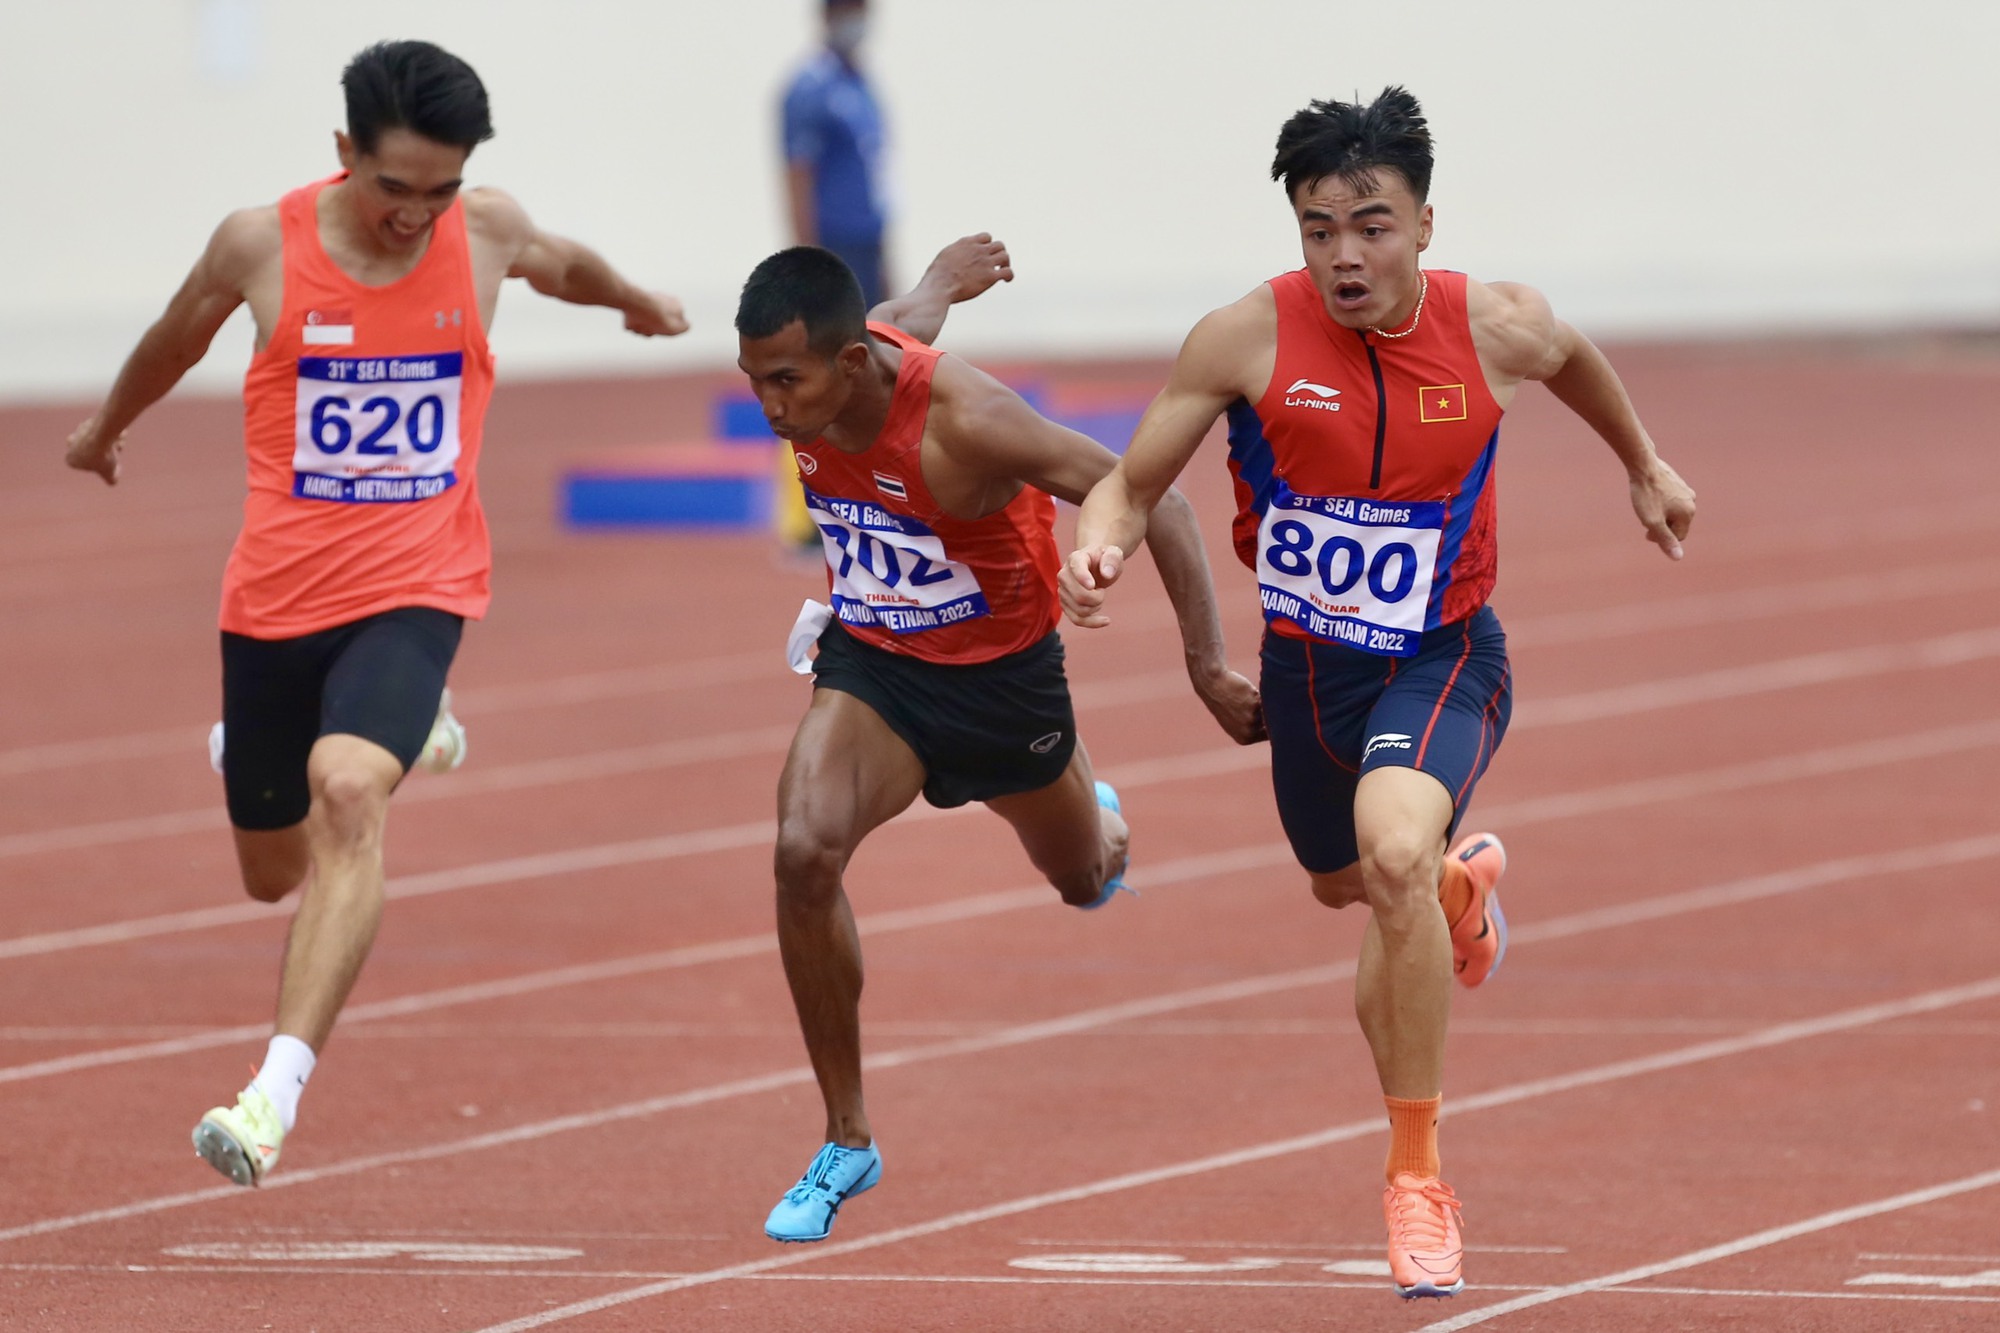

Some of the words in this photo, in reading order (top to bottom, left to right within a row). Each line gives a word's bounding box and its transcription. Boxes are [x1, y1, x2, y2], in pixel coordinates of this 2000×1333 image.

[357, 360, 387, 380] SEA
[389, 360, 437, 379] Games
[1285, 397, 1341, 411] LI-NING
[310, 394, 444, 455] 620
[354, 478, 414, 500] VIETNAM
[831, 502, 860, 525] SEA
[1325, 498, 1355, 519] SEA
[1359, 503, 1411, 523] Games
[818, 523, 954, 589] 702
[1266, 519, 1418, 604] 800
[865, 594, 920, 605] THAILAD
[1309, 592, 1360, 614] VIETNAM
[938, 600, 975, 624] 2022
[1261, 589, 1301, 619] HANOI
[1309, 611, 1368, 645] VIETNAM
[1368, 629, 1406, 651] 2022
